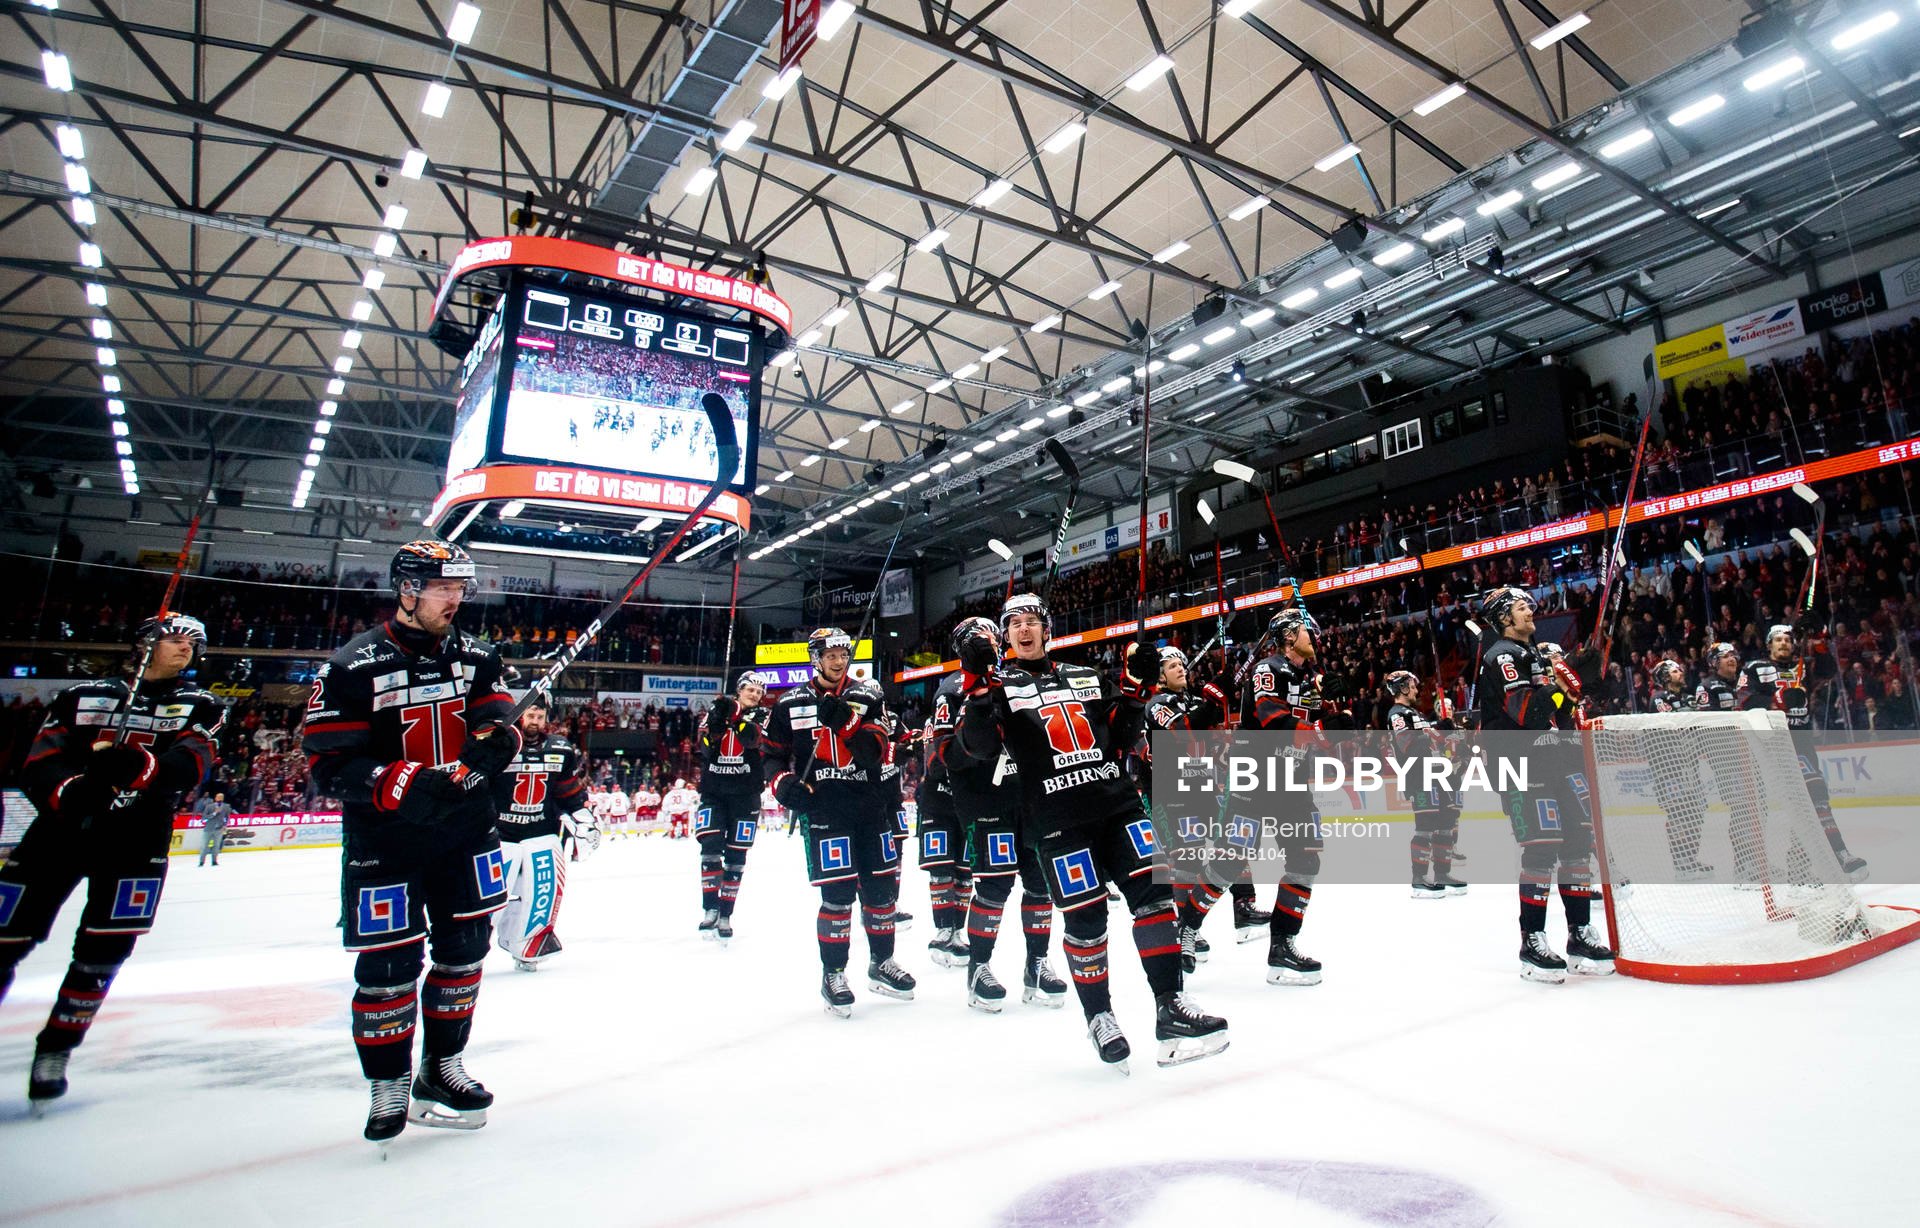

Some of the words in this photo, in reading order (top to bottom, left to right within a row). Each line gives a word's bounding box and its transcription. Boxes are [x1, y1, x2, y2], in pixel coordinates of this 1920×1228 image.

[616, 256, 651, 281] DET
[677, 270, 693, 290] VI
[694, 275, 730, 299] SOM
[1809, 291, 1849, 313] make
[1832, 291, 1876, 318] brand
[681, 327, 691, 340] 2
[1729, 320, 1795, 344] Weidermans
[1878, 444, 1908, 463] DET
[534, 471, 573, 493] DET
[603, 478, 620, 499] VI
[621, 481, 661, 503] SOM
[1644, 502, 1667, 516] DET
[1686, 493, 1700, 507] VI
[1701, 487, 1729, 504] SOM
[1462, 545, 1480, 558] DET
[1506, 533, 1529, 547] SOM
[502, 576, 542, 587] TRAVEL
[788, 669, 810, 683] NA
[1252, 672, 1275, 693] 33
[1501, 663, 1518, 681] 6
[308, 678, 325, 712] 2
[648, 677, 718, 692] Vintergatan
[1077, 688, 1098, 698] OBK
[937, 704, 949, 722] 4
[1154, 705, 1174, 727] 21
[1058, 751, 1100, 765] ÖREBRO
[391, 761, 424, 800] BAU
[1042, 766, 1103, 795] BEHRN
[531, 855, 552, 924] HEROK
[1074, 966, 1108, 978] STILL
[363, 1021, 416, 1038] STILL
